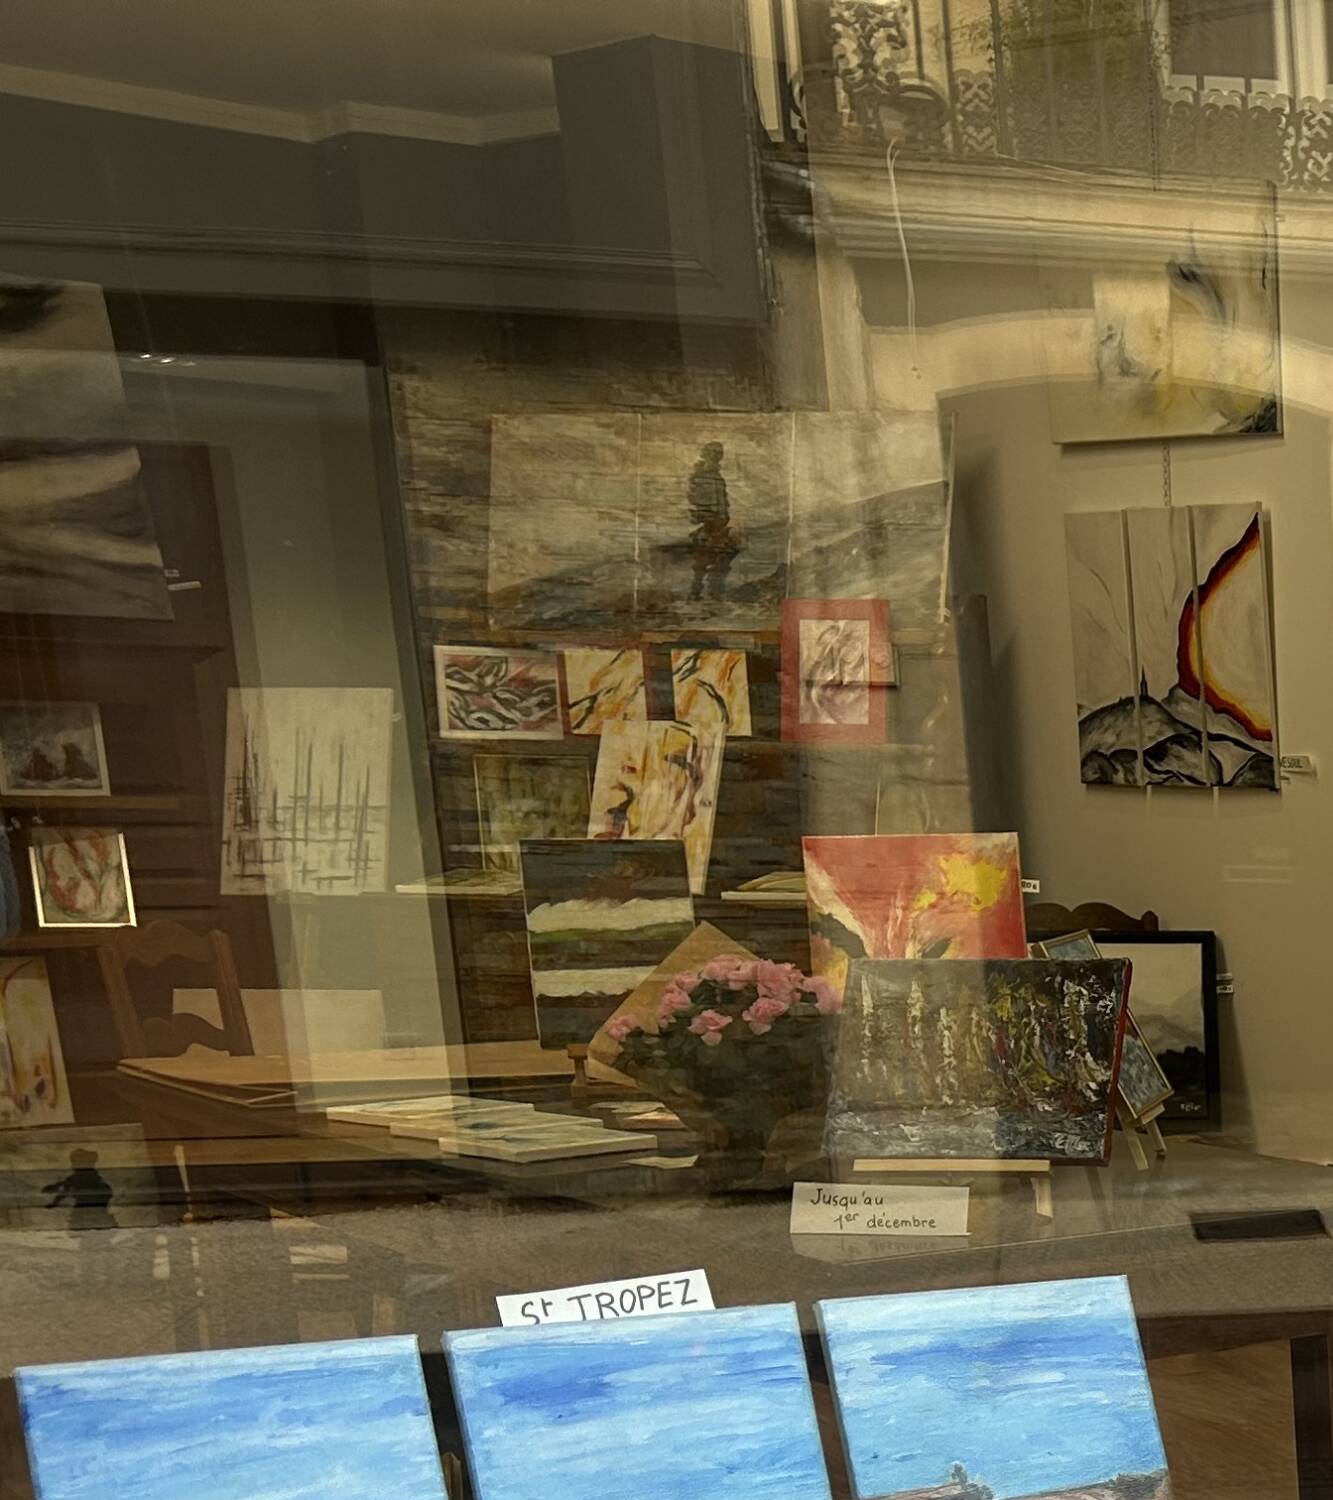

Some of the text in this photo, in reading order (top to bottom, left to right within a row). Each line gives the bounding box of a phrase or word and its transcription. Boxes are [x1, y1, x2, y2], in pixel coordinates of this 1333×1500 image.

[810, 1188, 884, 1211] Jusqu'au
[867, 1212, 937, 1229] décembre
[566, 1278, 698, 1321] TROPEZ
